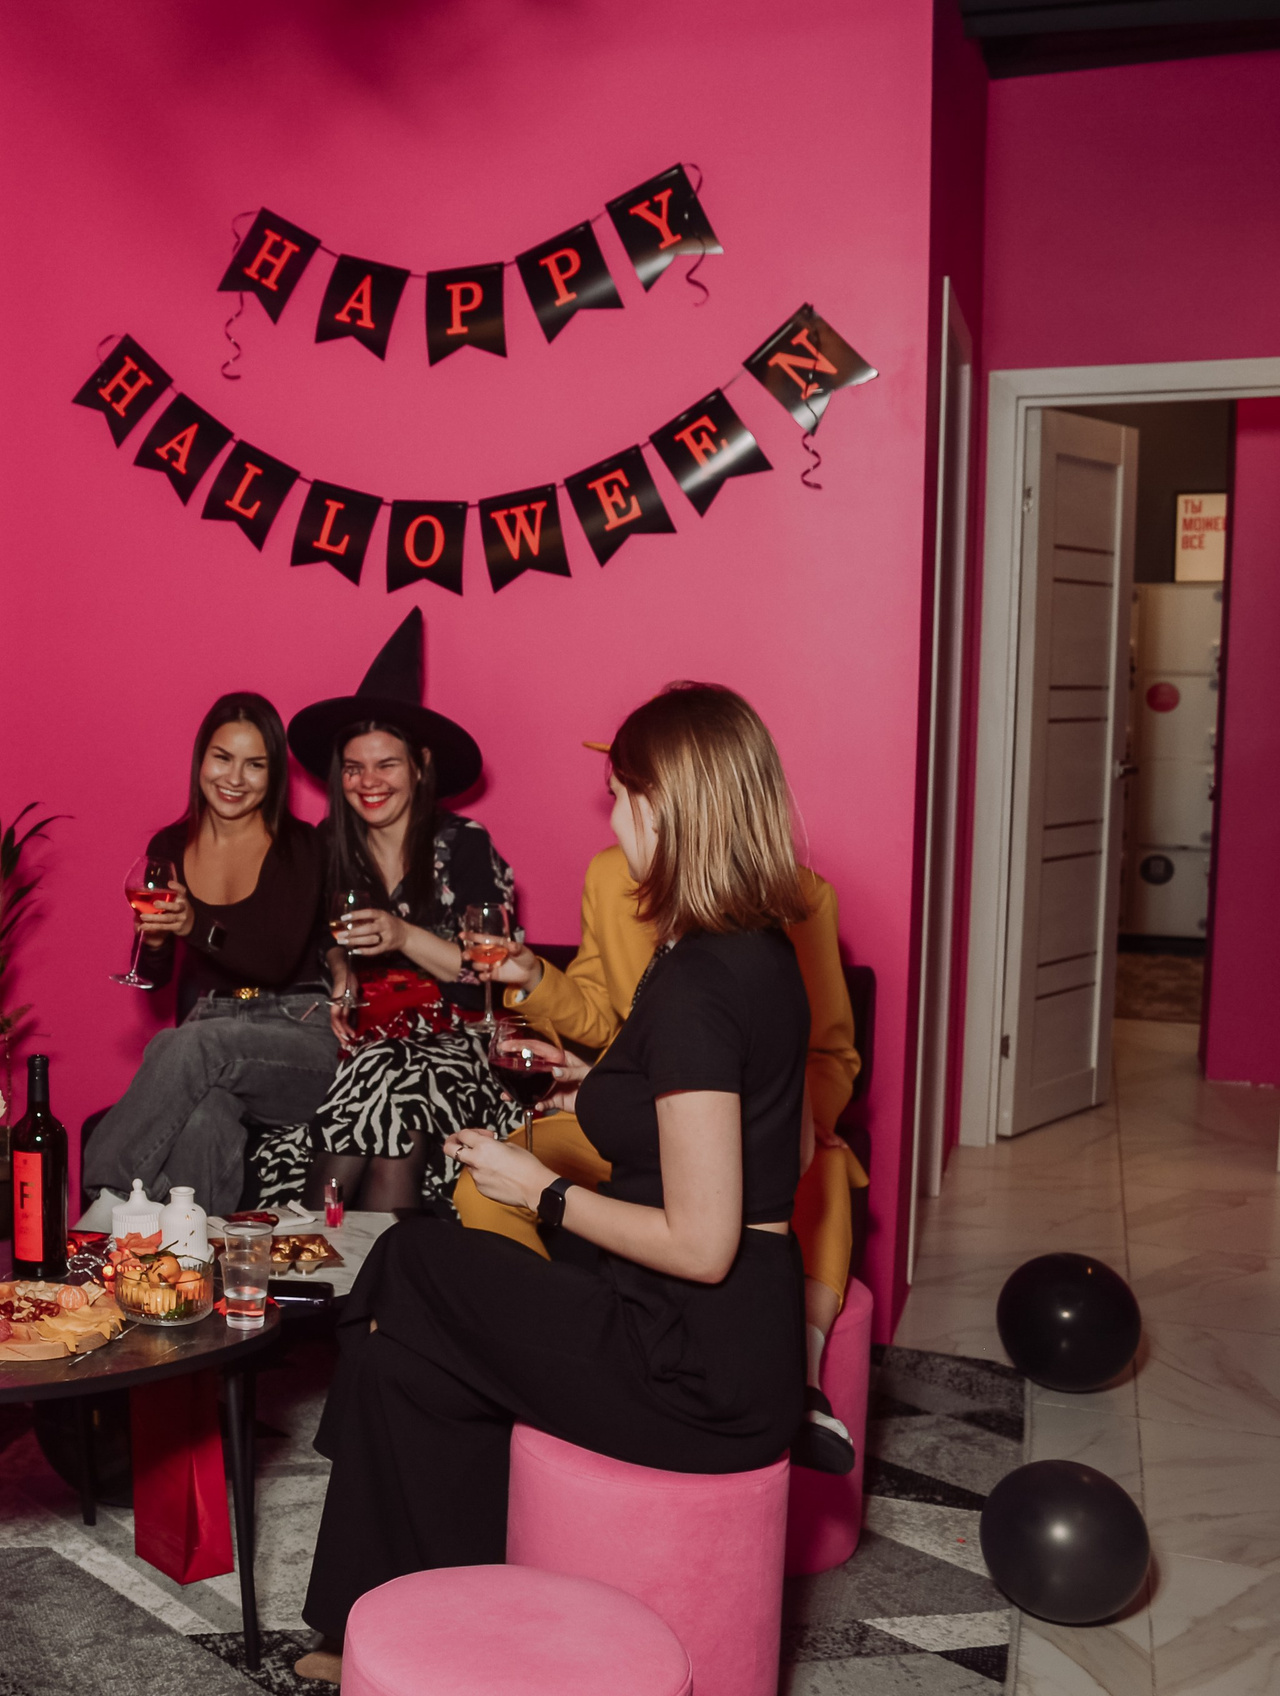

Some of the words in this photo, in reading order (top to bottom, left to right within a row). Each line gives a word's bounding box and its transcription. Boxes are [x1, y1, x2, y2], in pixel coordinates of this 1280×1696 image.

[242, 187, 685, 338] HAPPY
[97, 327, 839, 569] HALLOWEEN
[1183, 499, 1202, 514] ТЫ
